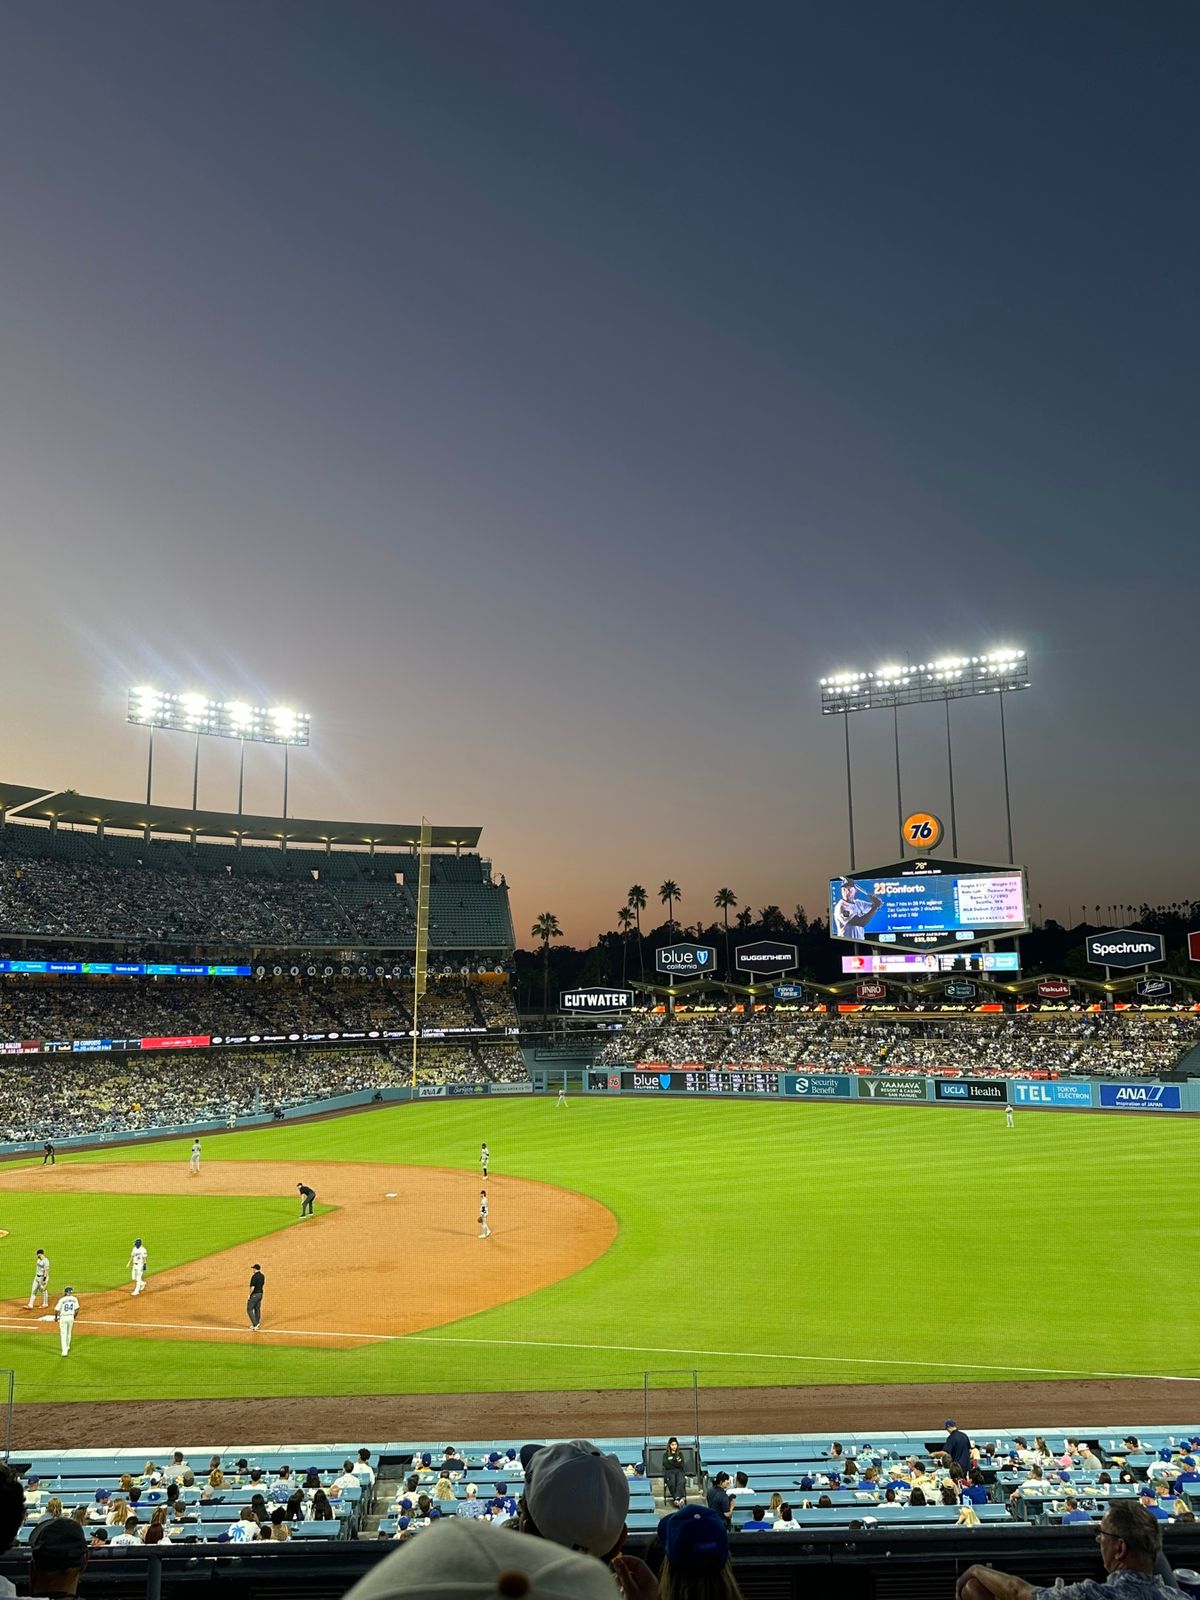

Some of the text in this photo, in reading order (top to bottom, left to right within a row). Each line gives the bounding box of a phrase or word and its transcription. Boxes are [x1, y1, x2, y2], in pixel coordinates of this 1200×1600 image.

[910, 822, 932, 840] 76
[886, 885, 925, 894] Conforto
[1092, 942, 1151, 956] Spectrum
[662, 950, 693, 963] blue
[862, 986, 881, 995] JINRO
[565, 993, 627, 1007] CUTWATER
[634, 1074, 659, 1085] blue
[970, 1087, 1001, 1097] Health
[1016, 1085, 1051, 1101] TEL
[1116, 1088, 1147, 1100] ANA
[64, 1304, 74, 1312] 84
